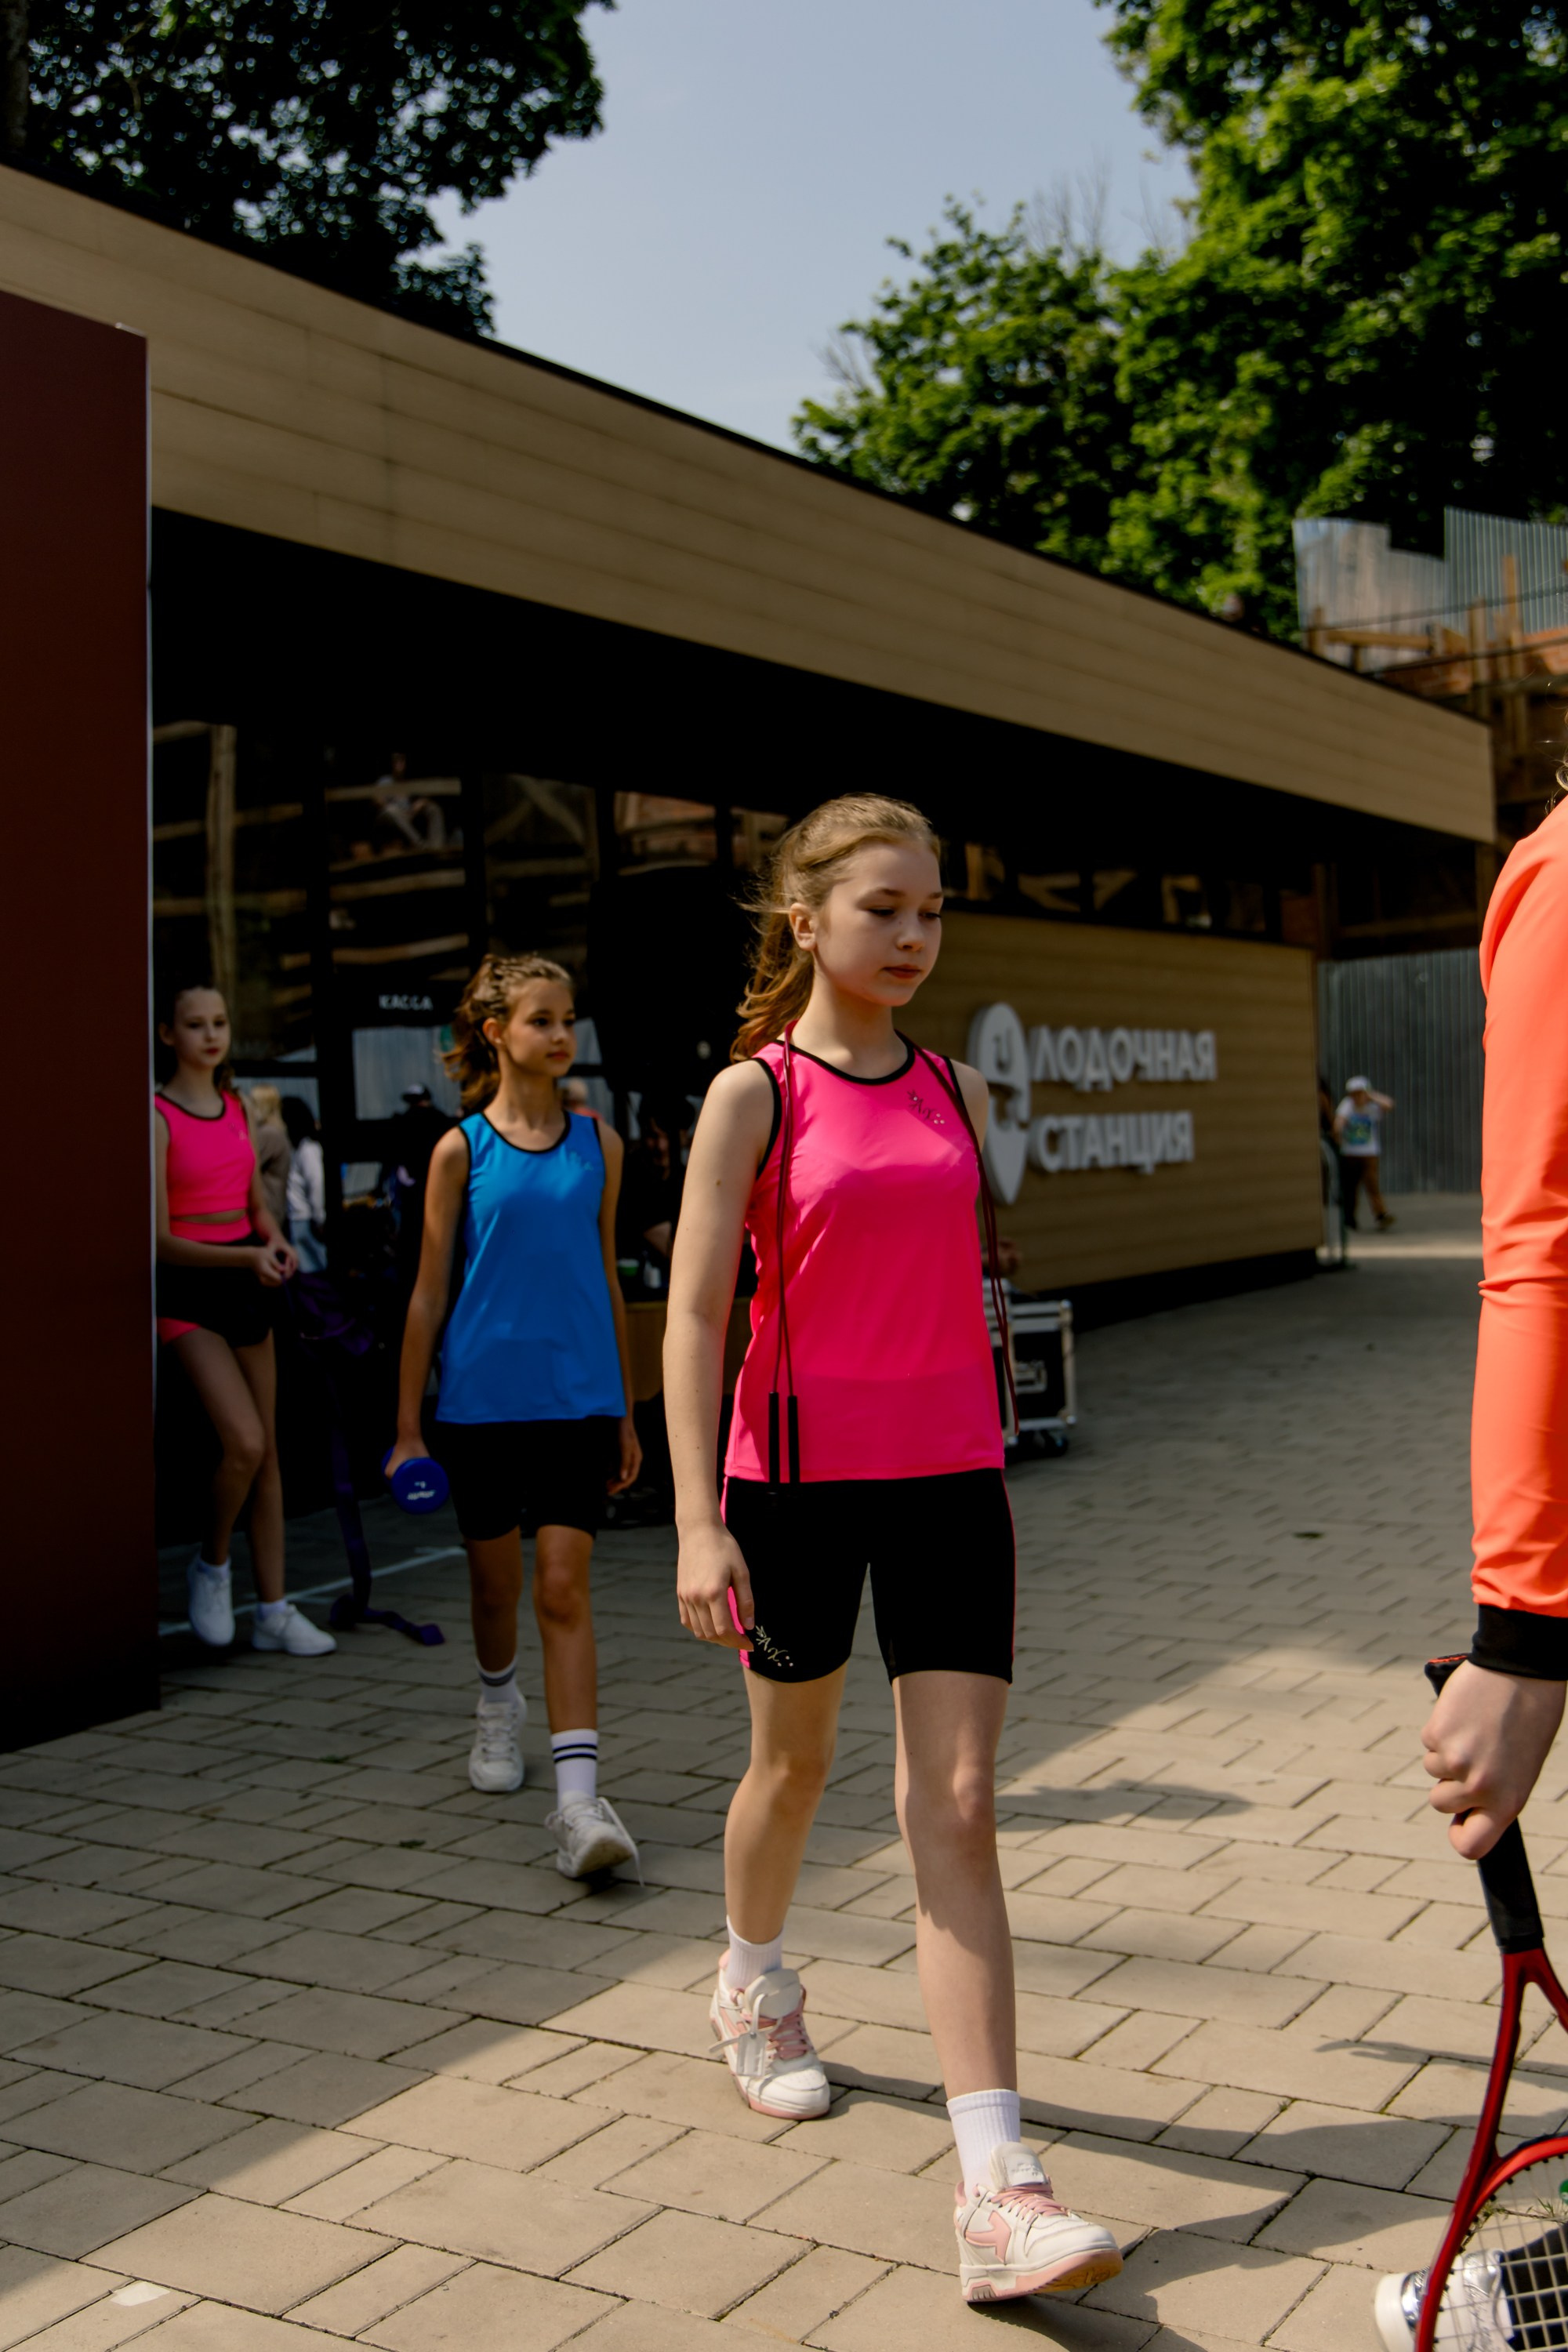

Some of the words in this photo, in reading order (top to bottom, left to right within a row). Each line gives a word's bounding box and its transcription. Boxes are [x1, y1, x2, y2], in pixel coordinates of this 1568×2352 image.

[379, 994, 433, 1011] КАССА
[1029, 1025, 1216, 1091] ЛОДОЧНАЯ
[1031, 1111, 1194, 1174] СТАНЦИЯ
